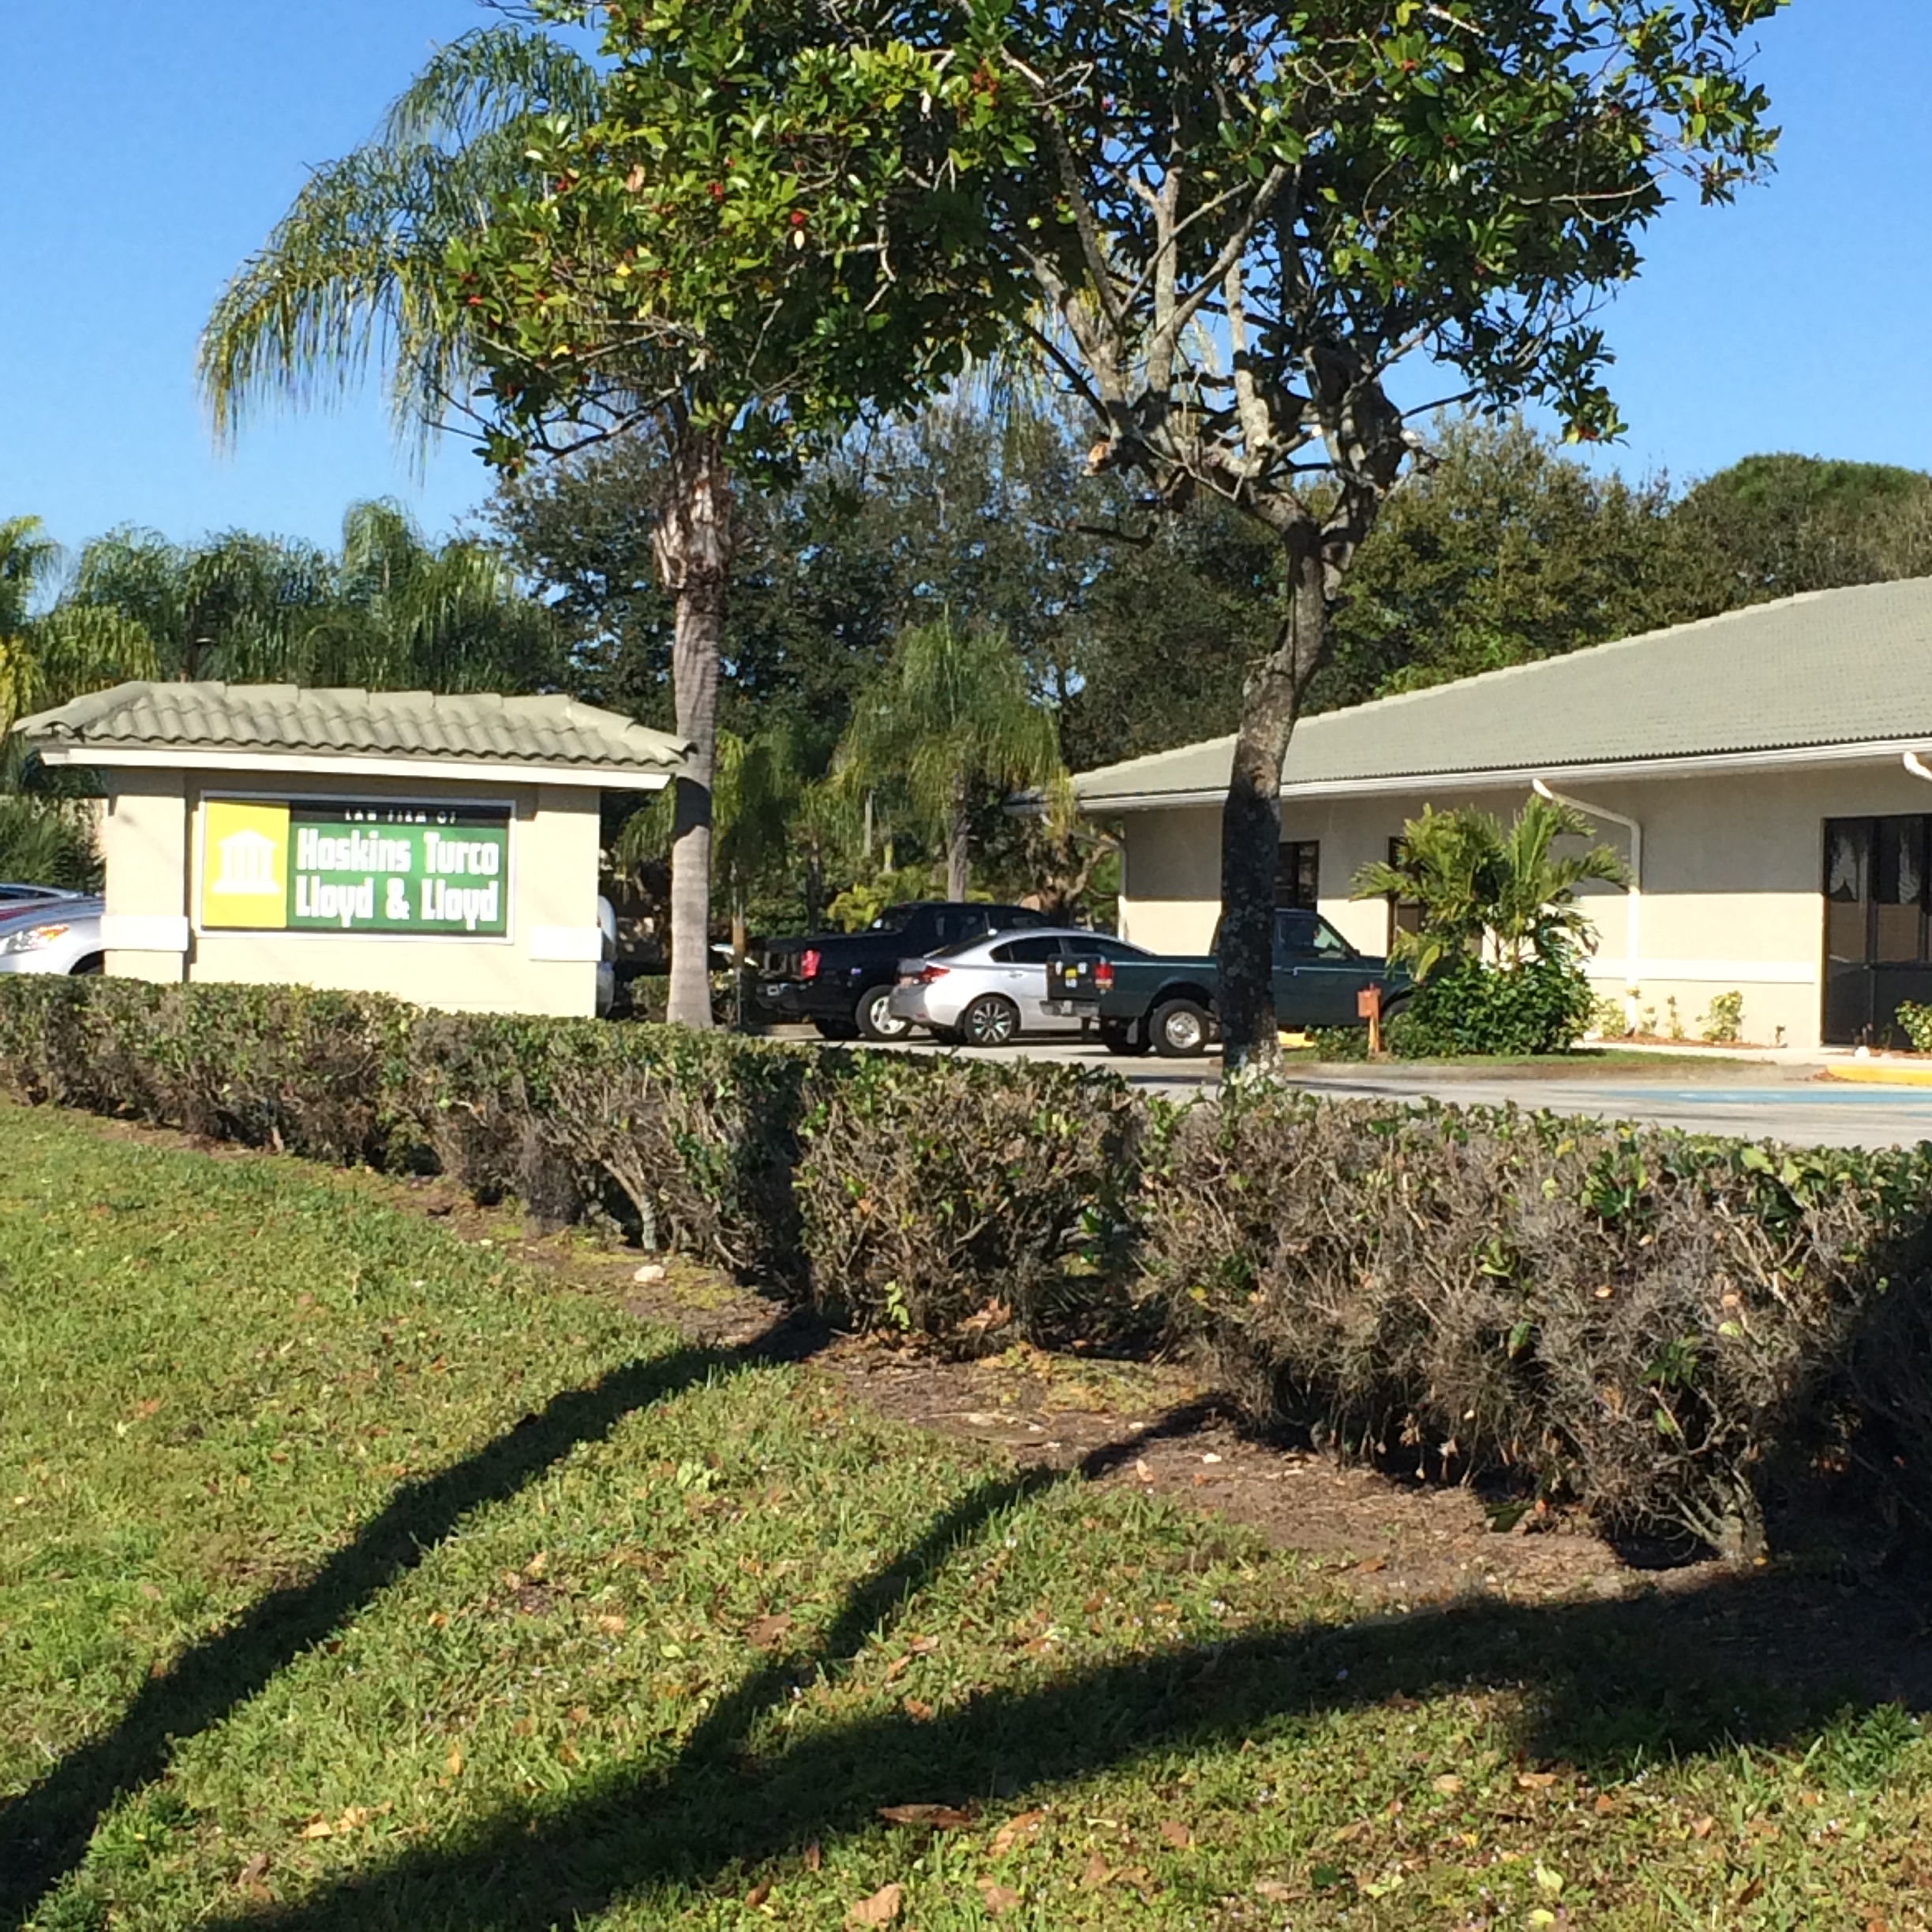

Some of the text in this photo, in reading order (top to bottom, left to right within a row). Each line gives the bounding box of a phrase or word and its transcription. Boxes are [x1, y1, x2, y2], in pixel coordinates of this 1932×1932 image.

[297, 828, 500, 875] Hoskins Turco
[295, 874, 499, 930] Lloyd & Lloyd
